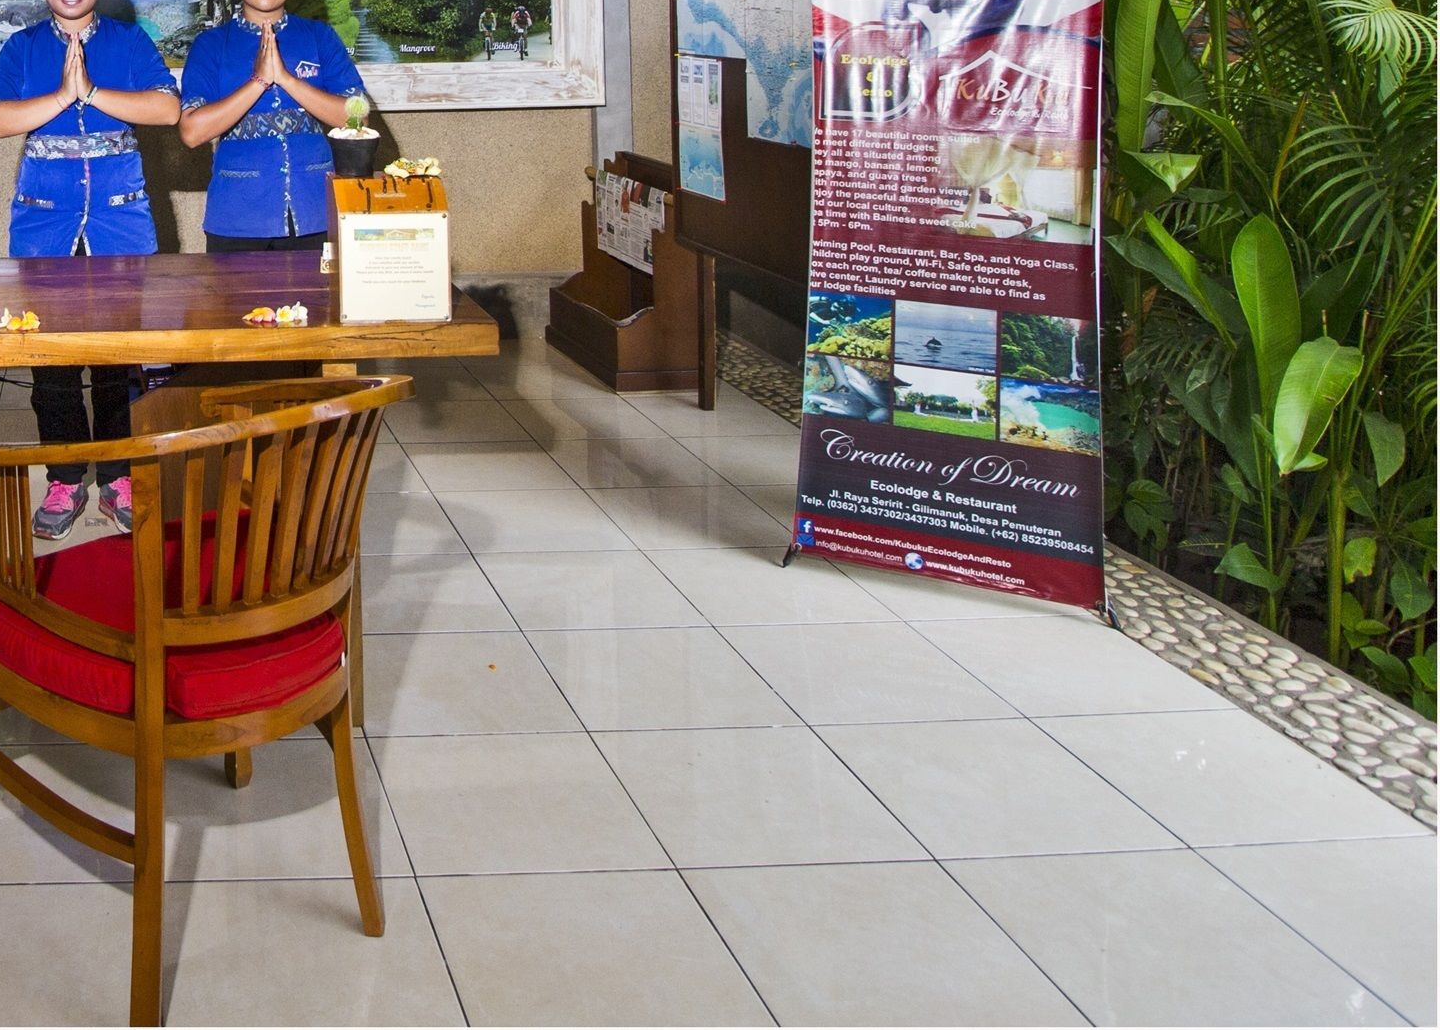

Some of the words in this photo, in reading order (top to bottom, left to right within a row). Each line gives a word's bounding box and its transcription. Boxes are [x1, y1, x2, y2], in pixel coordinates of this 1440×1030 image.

[399, 44, 436, 54] Mangrove
[492, 42, 519, 53] Biking
[825, 128, 849, 137] have
[852, 129, 864, 137] 17
[865, 130, 909, 140] beautiful
[912, 133, 945, 142] rooms
[822, 139, 847, 147] meet
[848, 139, 892, 149] different
[893, 142, 937, 152] budgets.
[830, 149, 843, 157] all
[844, 150, 860, 158] are
[863, 150, 904, 160] situated
[906, 154, 941, 165] among
[825, 160, 862, 169] mango,
[864, 161, 904, 172] banana,
[906, 163, 941, 174] lemon,
[847, 171, 866, 179] and
[868, 172, 899, 181] guava
[901, 173, 928, 183] trees
[829, 180, 876, 190] mountain
[878, 183, 898, 191] and
[900, 185, 936, 194] garden
[939, 186, 972, 197] views.
[835, 189, 852, 198] the
[854, 192, 896, 201] peaceful
[846, 200, 870, 210] local
[872, 203, 911, 213] culture.
[817, 218, 840, 228] 5Pm
[848, 221, 873, 231] 6Pm.
[825, 209, 847, 219] time
[849, 211, 870, 220] with
[872, 212, 917, 224] Balinese
[919, 218, 950, 227] sweet
[952, 220, 977, 229] cake
[849, 253, 871, 263] play
[872, 255, 912, 267] ground,
[914, 258, 945, 269] Wi-Fi,
[947, 261, 971, 271] Safe
[973, 264, 1021, 276] deposite
[850, 242, 876, 253] Pool,
[878, 244, 937, 258] Restaurant,
[939, 250, 961, 260] Bar,
[963, 252, 987, 263] Spa,
[990, 255, 1010, 265] and
[1013, 256, 1041, 268] Yoga
[1043, 259, 1078, 271] Class,
[825, 261, 849, 270] each
[851, 265, 881, 274] room,
[883, 266, 902, 276] tea/
[905, 269, 937, 279] coffee
[939, 272, 975, 284] maker,
[977, 275, 1000, 285] tour
[1002, 278, 1032, 289] desk,
[823, 280, 852, 292] lodge
[853, 284, 896, 296] facilities
[828, 271, 862, 282] center,
[865, 275, 907, 288] Laundry
[909, 279, 947, 290] service
[949, 284, 967, 292] are
[969, 286, 992, 296] able
[994, 288, 1006, 297] to
[1008, 289, 1030, 299] find
[1032, 293, 1046, 301] as
[820, 428, 936, 474] Creation
[938, 457, 974, 486] of
[969, 455, 1081, 498] Dream
[870, 480, 929, 499] Ecolodge
[932, 490, 942, 501] &
[945, 492, 1018, 514] Restaurant
[829, 490, 842, 499] Jl.
[844, 491, 870, 505] Raya
[871, 497, 903, 510] Seririt
[912, 504, 968, 522] Gilimanuk,
[971, 513, 999, 526] Desa
[1001, 519, 1062, 538] Pemuteran
[801, 494, 824, 507] Telp.
[827, 499, 858, 513] (0362)
[860, 505, 947, 529] 3437302/3437303
[949, 521, 989, 536] Mobile.
[991, 528, 1019, 543] (+62)
[1021, 534, 1094, 555] 85239508454
[814, 526, 1012, 568] www.facebook.com/KubukuEcolodgeAndResto
[815, 540, 903, 563] info@kubukuhotel.com
[925, 561, 1025, 585] www.kubukuhotel.com
